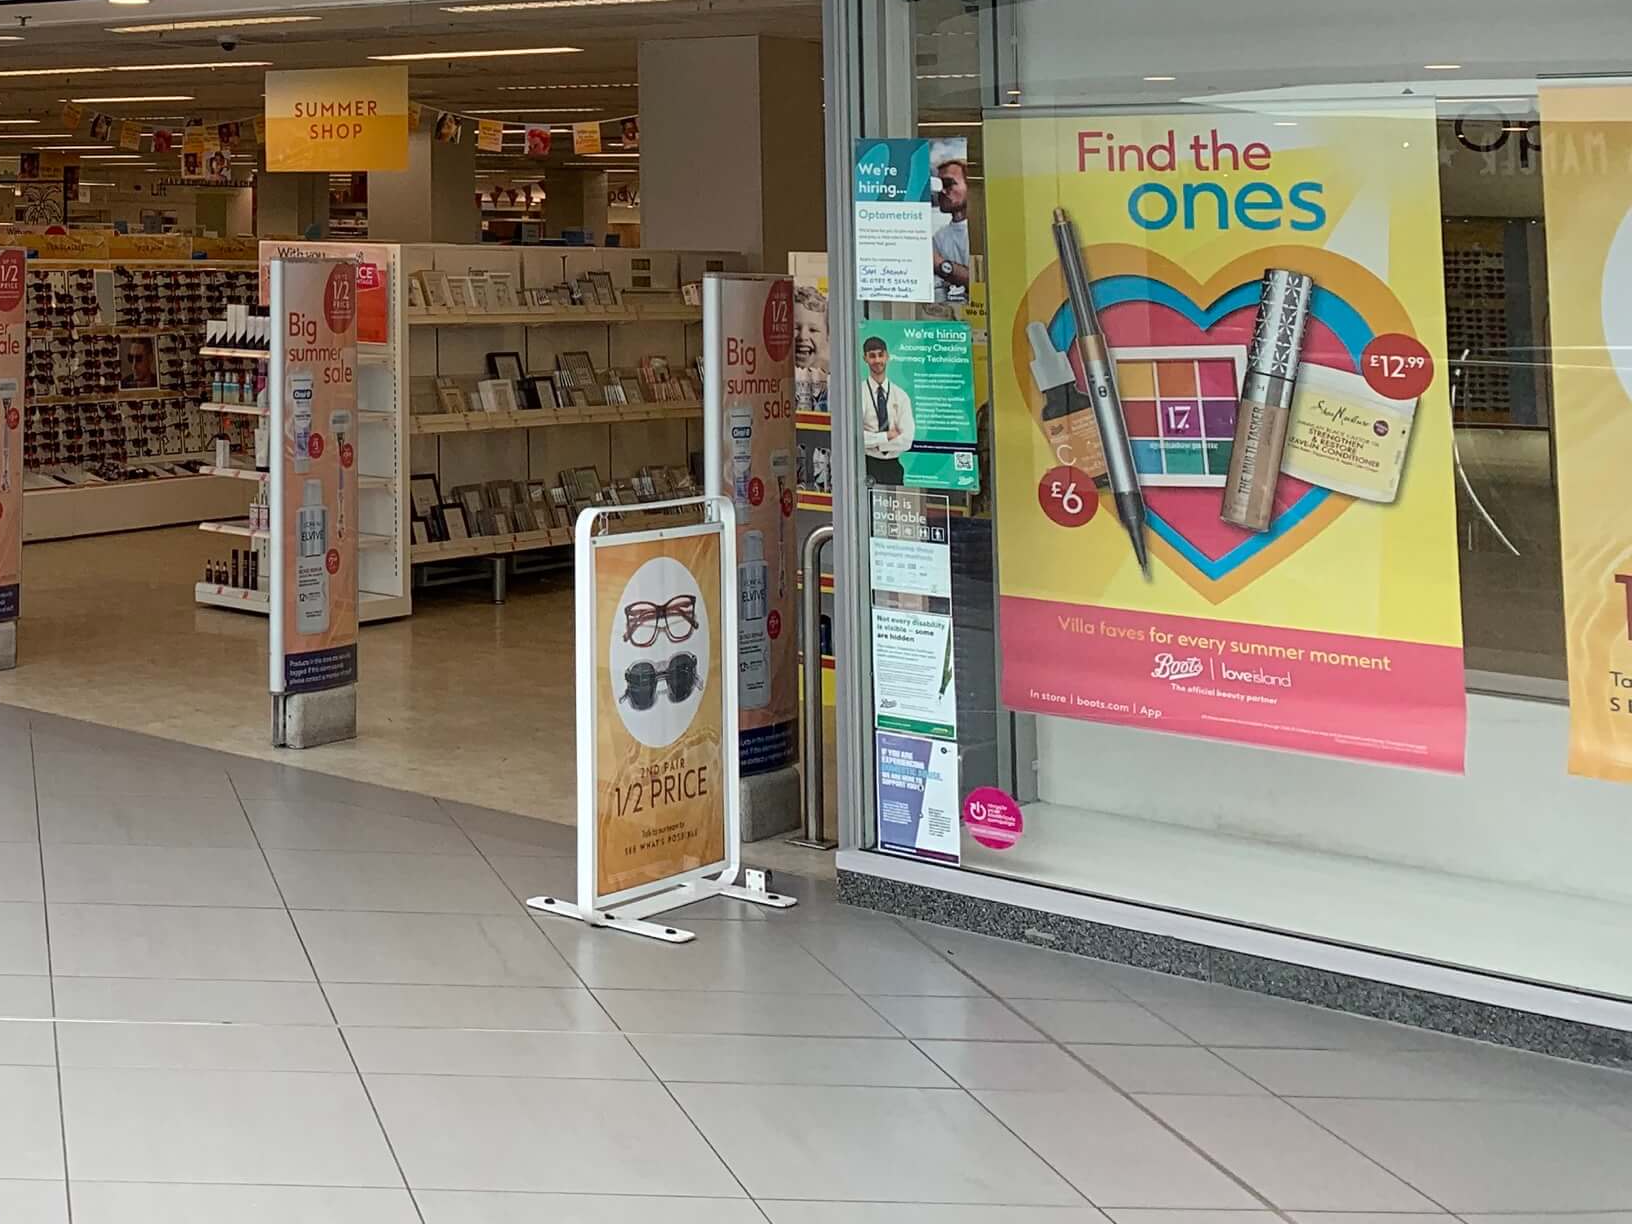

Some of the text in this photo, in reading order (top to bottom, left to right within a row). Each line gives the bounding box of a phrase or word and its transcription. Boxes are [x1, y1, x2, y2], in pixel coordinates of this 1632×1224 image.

[294, 100, 377, 118] SUMMER
[309, 122, 363, 140] SHOP
[1077, 128, 1271, 172] Find the
[858, 163, 897, 176] We're
[858, 181, 907, 198] hiring...
[858, 209, 923, 222] Optometrist
[1127, 181, 1327, 231] ones
[0, 265, 19, 282] 1/2
[333, 280, 350, 300] 1/2
[771, 300, 788, 323] 1/2
[289, 312, 317, 345] Big
[904, 328, 967, 342] We're hiring
[289, 346, 342, 363] summer
[726, 337, 757, 375] Big
[899, 343, 967, 353] Accuracy Checking
[889, 354, 970, 364] Pharmacy Technicians
[1370, 354, 1425, 378] £12.99
[323, 359, 352, 384] sale
[727, 378, 782, 395] summer
[763, 391, 791, 420] sale
[1308, 428, 1364, 449] STRENGTHEN
[1320, 439, 1357, 454] RESTORE
[1321, 446, 1381, 468] CONDITIONER
[873, 494, 912, 511] Help is
[1050, 481, 1083, 514] £6
[873, 510, 927, 524] available
[890, 633, 915, 642] hidden
[1058, 615, 1392, 671] Villa faves for every summer moment
[1151, 652, 1204, 680] Boots
[1171, 682, 1278, 705] The official beauty partner
[1030, 689, 1162, 719] In store boots.com App
[664, 757, 685, 772] PAIR
[615, 765, 708, 817] 1/2 PRICE
